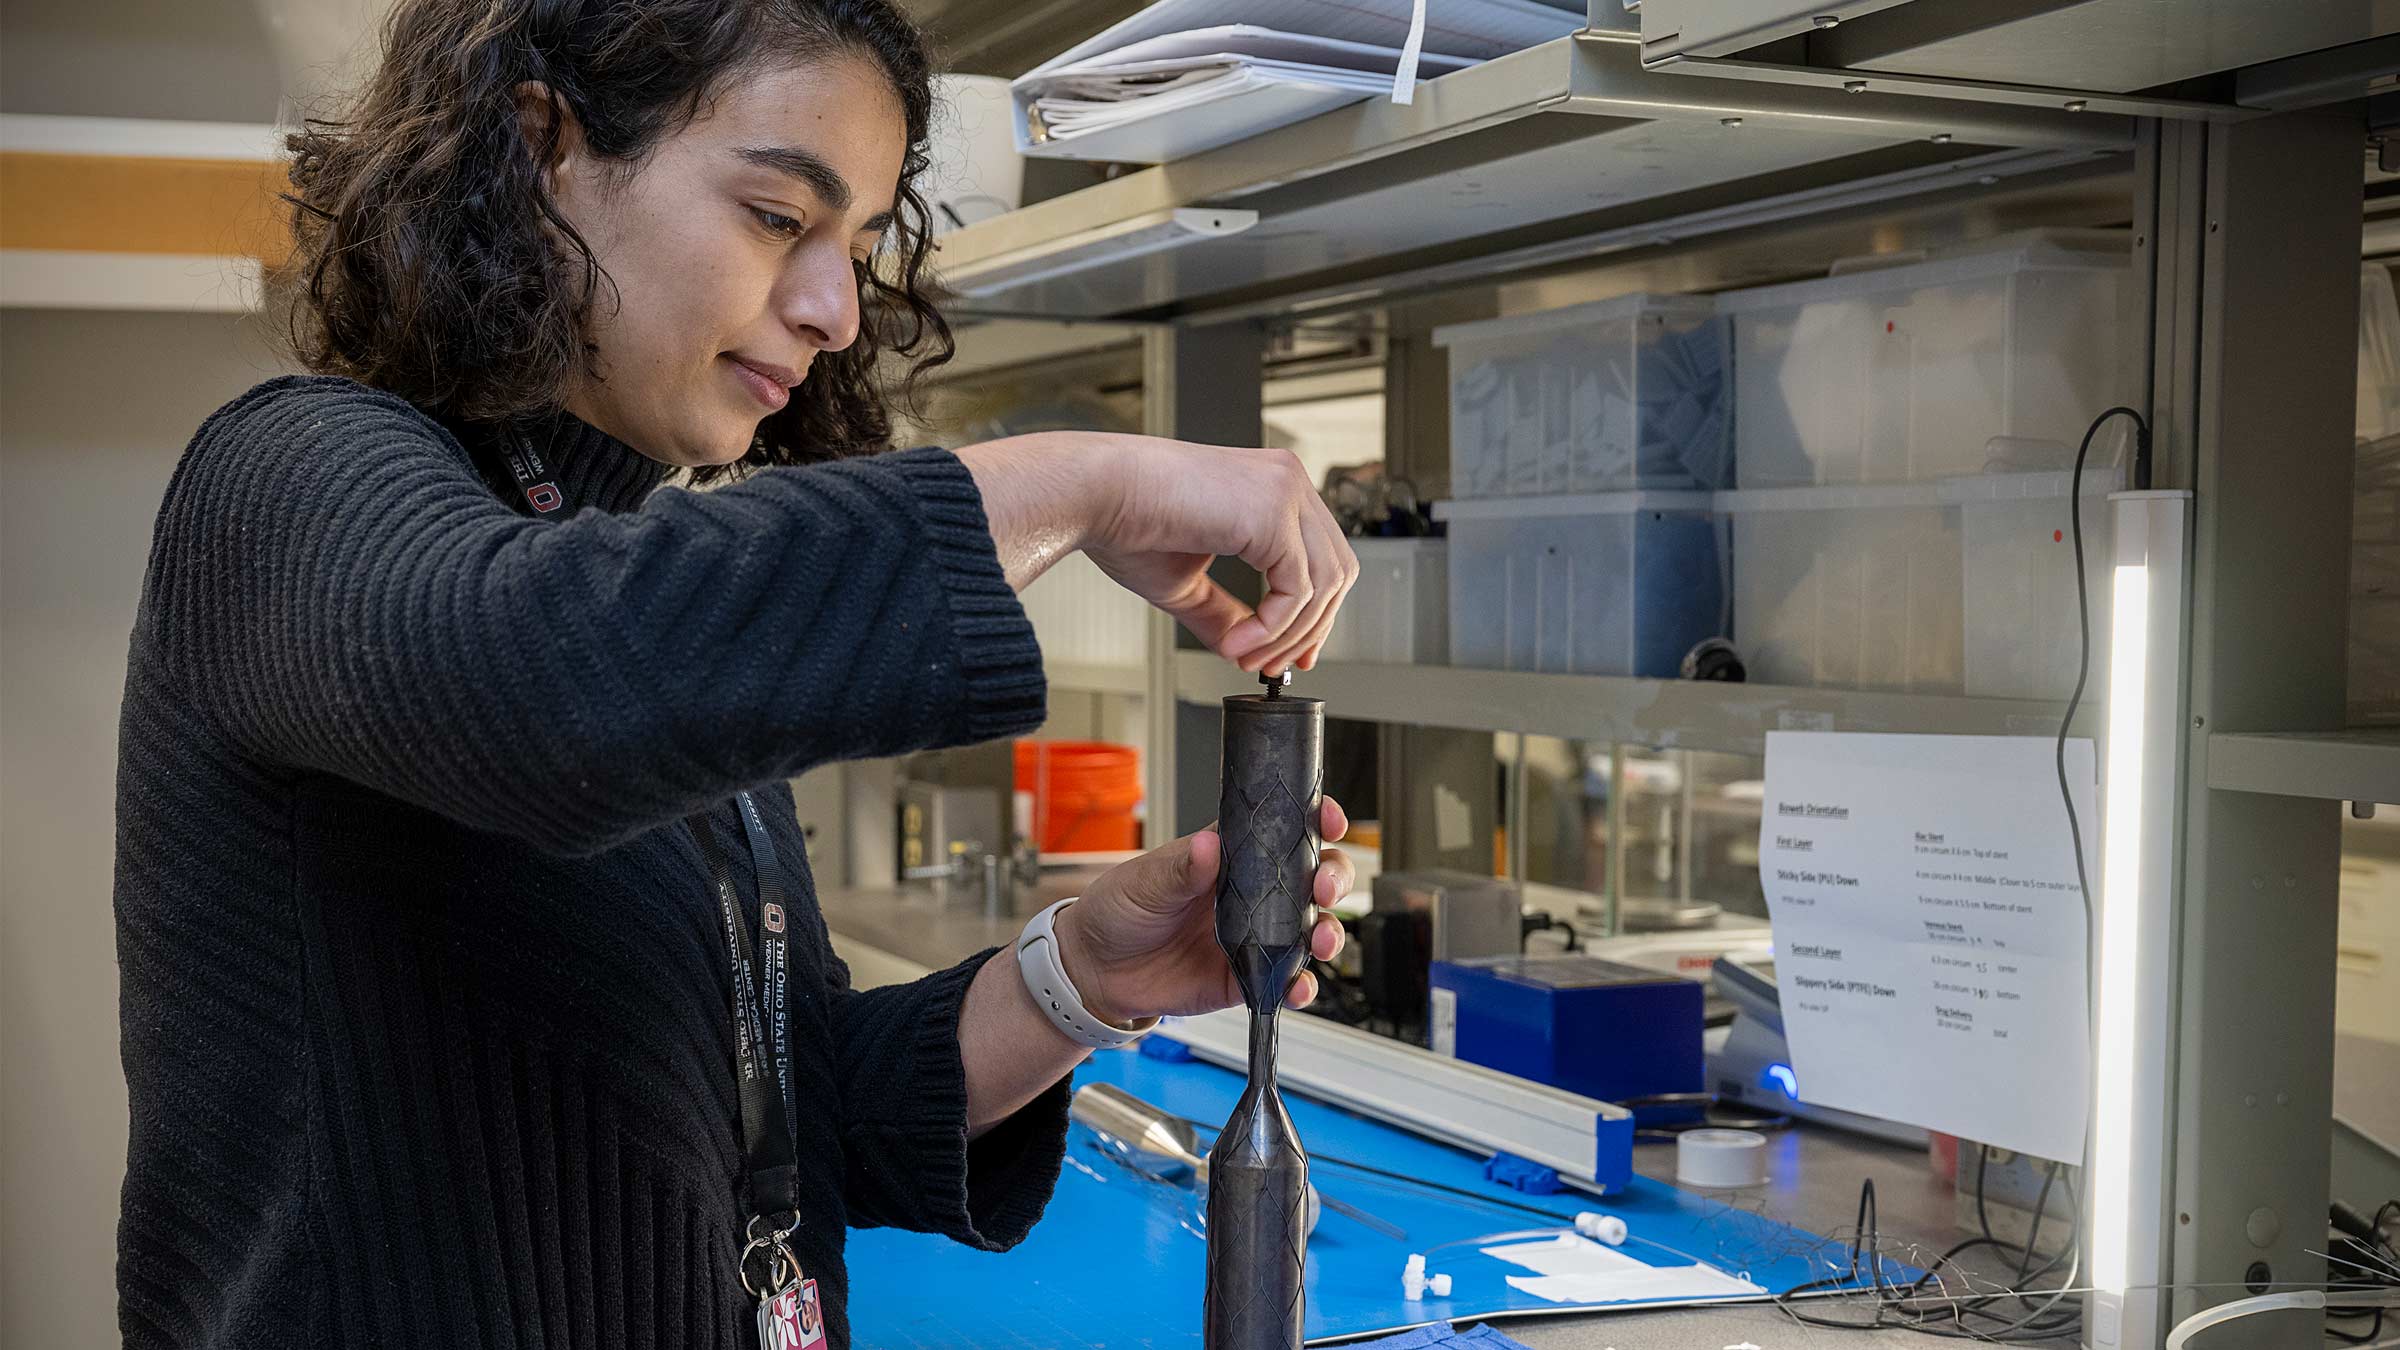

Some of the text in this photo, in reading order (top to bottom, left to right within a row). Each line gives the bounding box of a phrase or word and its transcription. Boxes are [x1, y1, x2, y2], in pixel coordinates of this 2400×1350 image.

[1777, 870, 1798, 882] Sticky
[1801, 871, 1815, 882] Side
[1836, 874, 1859, 887] Down
[764, 939, 773, 980] WEXNER
[775, 939, 786, 969] THE
[1791, 943, 1842, 960] Second Layer
[734, 974, 745, 1018] STATE
[742, 958, 756, 999] CENTER
[776, 973, 786, 1009] OHIO
[1829, 979, 1846, 990] Side
[1873, 985, 1896, 998] Down
[775, 1011, 786, 1054] STATE
